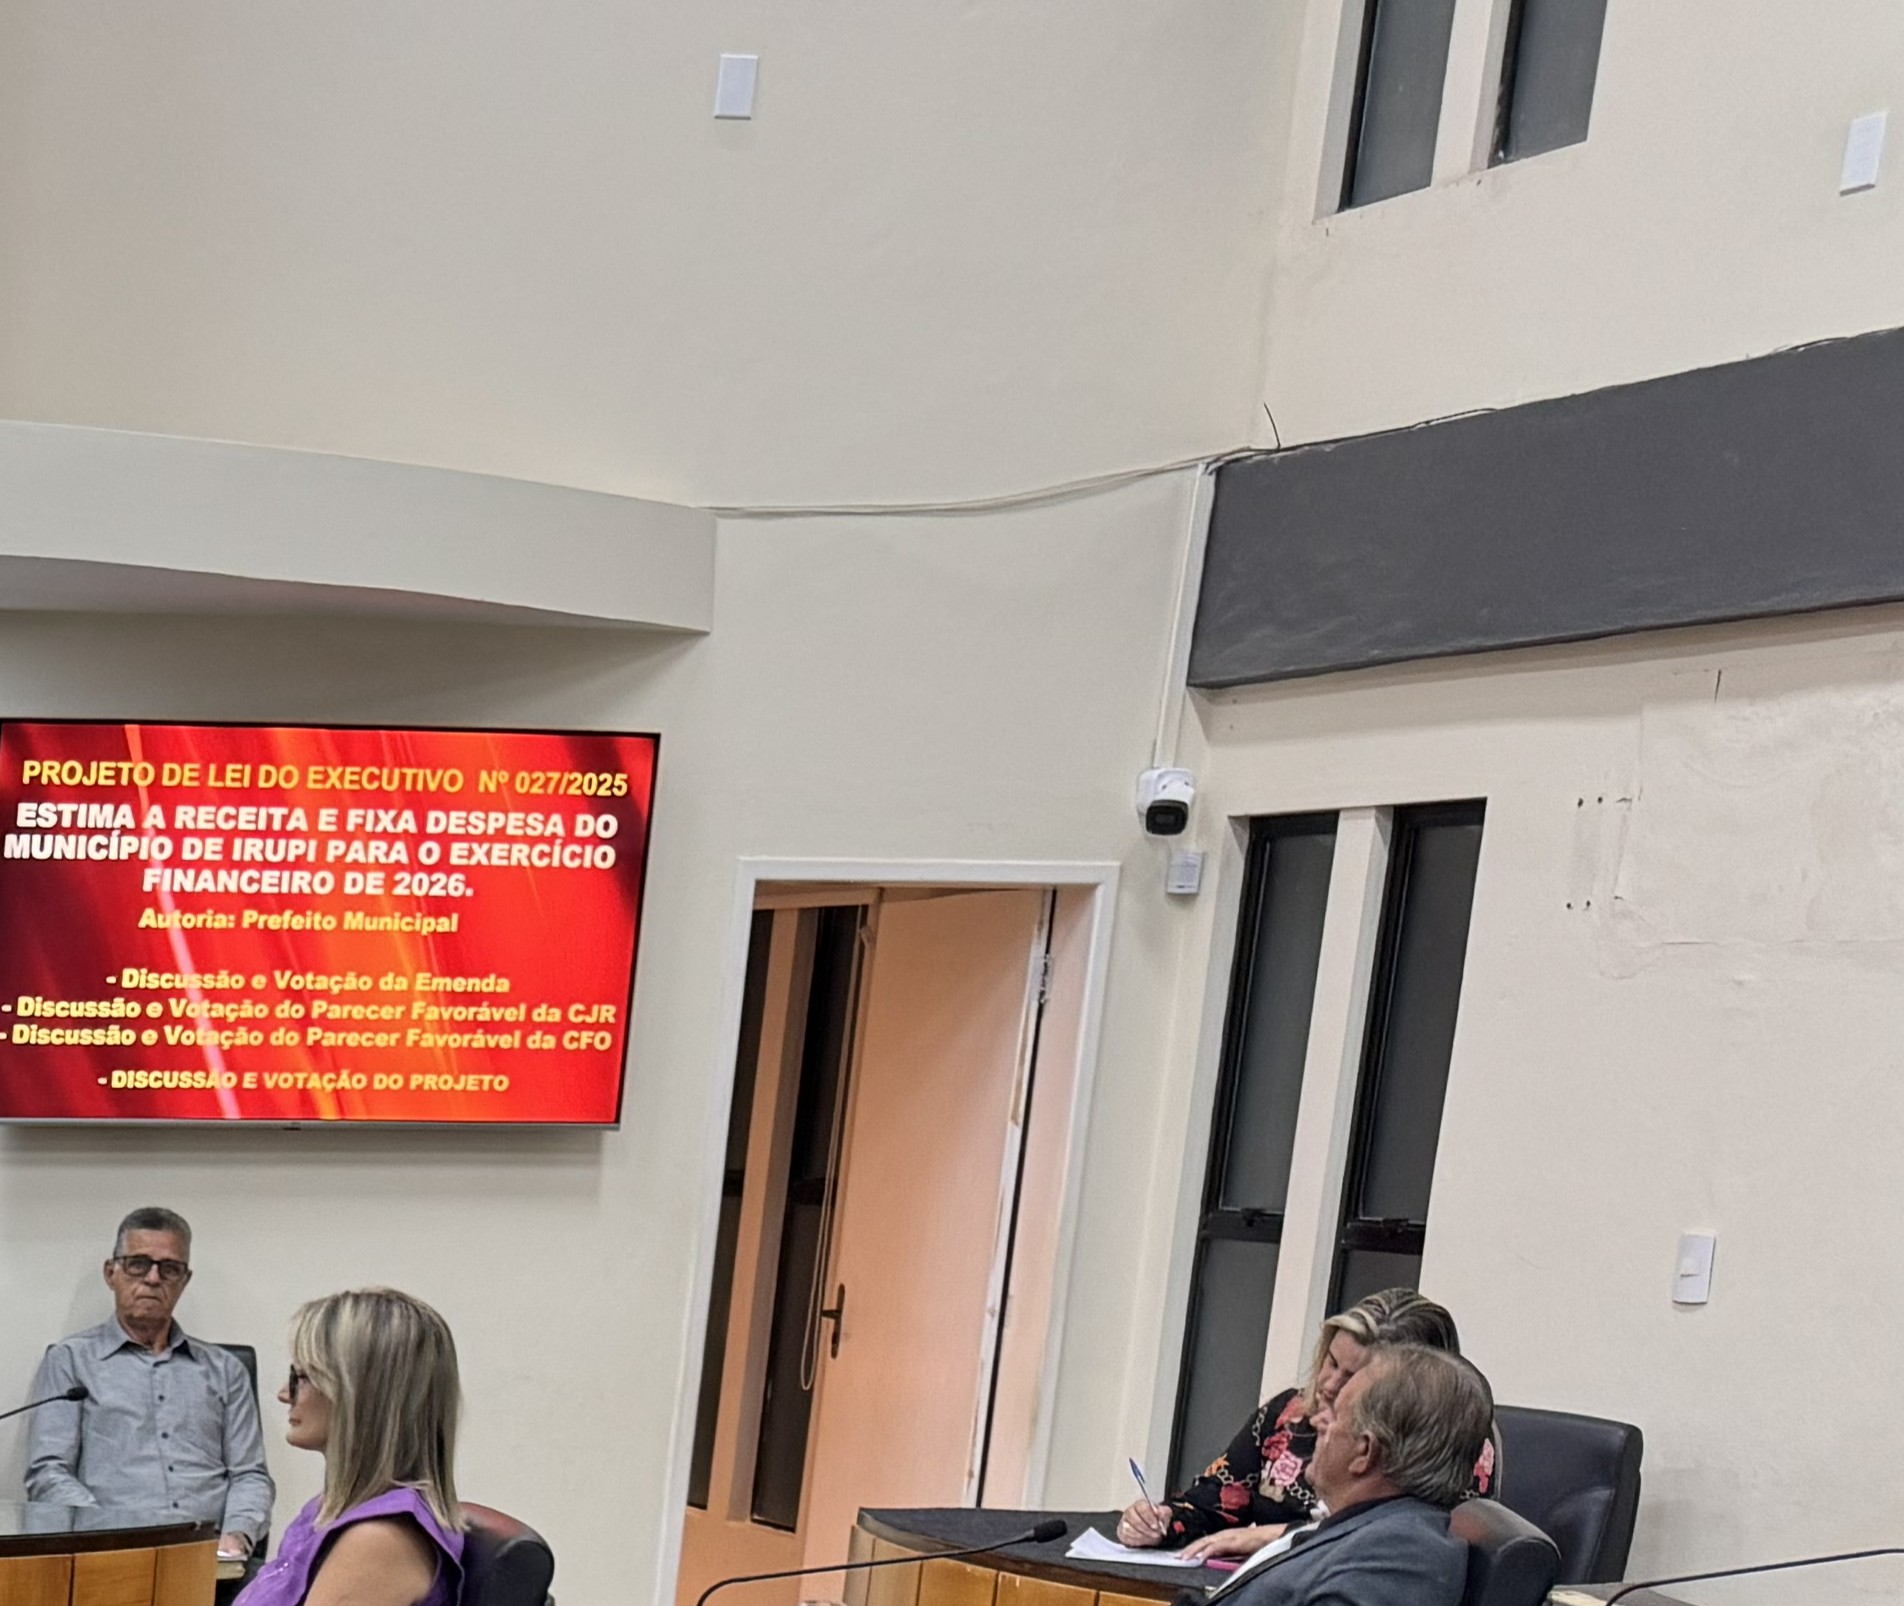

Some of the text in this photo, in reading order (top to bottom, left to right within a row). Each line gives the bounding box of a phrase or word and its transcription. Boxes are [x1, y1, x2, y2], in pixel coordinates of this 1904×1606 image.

[22, 761, 153, 785] PROJETO
[162, 764, 200, 786] DE
[209, 765, 250, 787] LEI
[259, 765, 298, 788] DO
[307, 766, 463, 791] EXECUTIVO
[515, 771, 627, 795] 027/2025
[16, 803, 618, 836] ESTIMA A RECEITA E FIXA DESPESA DO
[3, 831, 616, 867] MUNICÍPIO DE IRUPI PARA O EXERCÍCIO
[143, 870, 474, 896] FINANCEIRO DE 2026.
[138, 908, 459, 932] Autoria: Prefeito Municipal
[121, 968, 244, 988] Discussão
[251, 976, 266, 988] e
[273, 970, 372, 993] Votação
[379, 973, 410, 990] da
[415, 974, 510, 991] Emenda
[17, 996, 141, 1017] Discussão
[146, 1005, 162, 1018] e
[169, 999, 268, 1022] Votação
[274, 1002, 305, 1019] do
[311, 1003, 405, 1020] Parecer
[411, 1003, 526, 1022] Favorável
[532, 1004, 561, 1022] da
[567, 1004, 616, 1022] CJR
[12, 1024, 136, 1044] Discussão
[142, 1031, 158, 1045] e
[164, 1026, 263, 1050] Votação
[269, 1029, 300, 1046] do
[307, 1030, 400, 1048] Parecer
[405, 1030, 521, 1050] Favorável
[527, 1031, 557, 1048] da
[562, 1031, 612, 1050] CFO
[244, 1073, 256, 1086] E
[264, 1069, 367, 1092] VOTAÇÃO
[373, 1074, 402, 1089] DO
[410, 1075, 509, 1091] PROJETO
